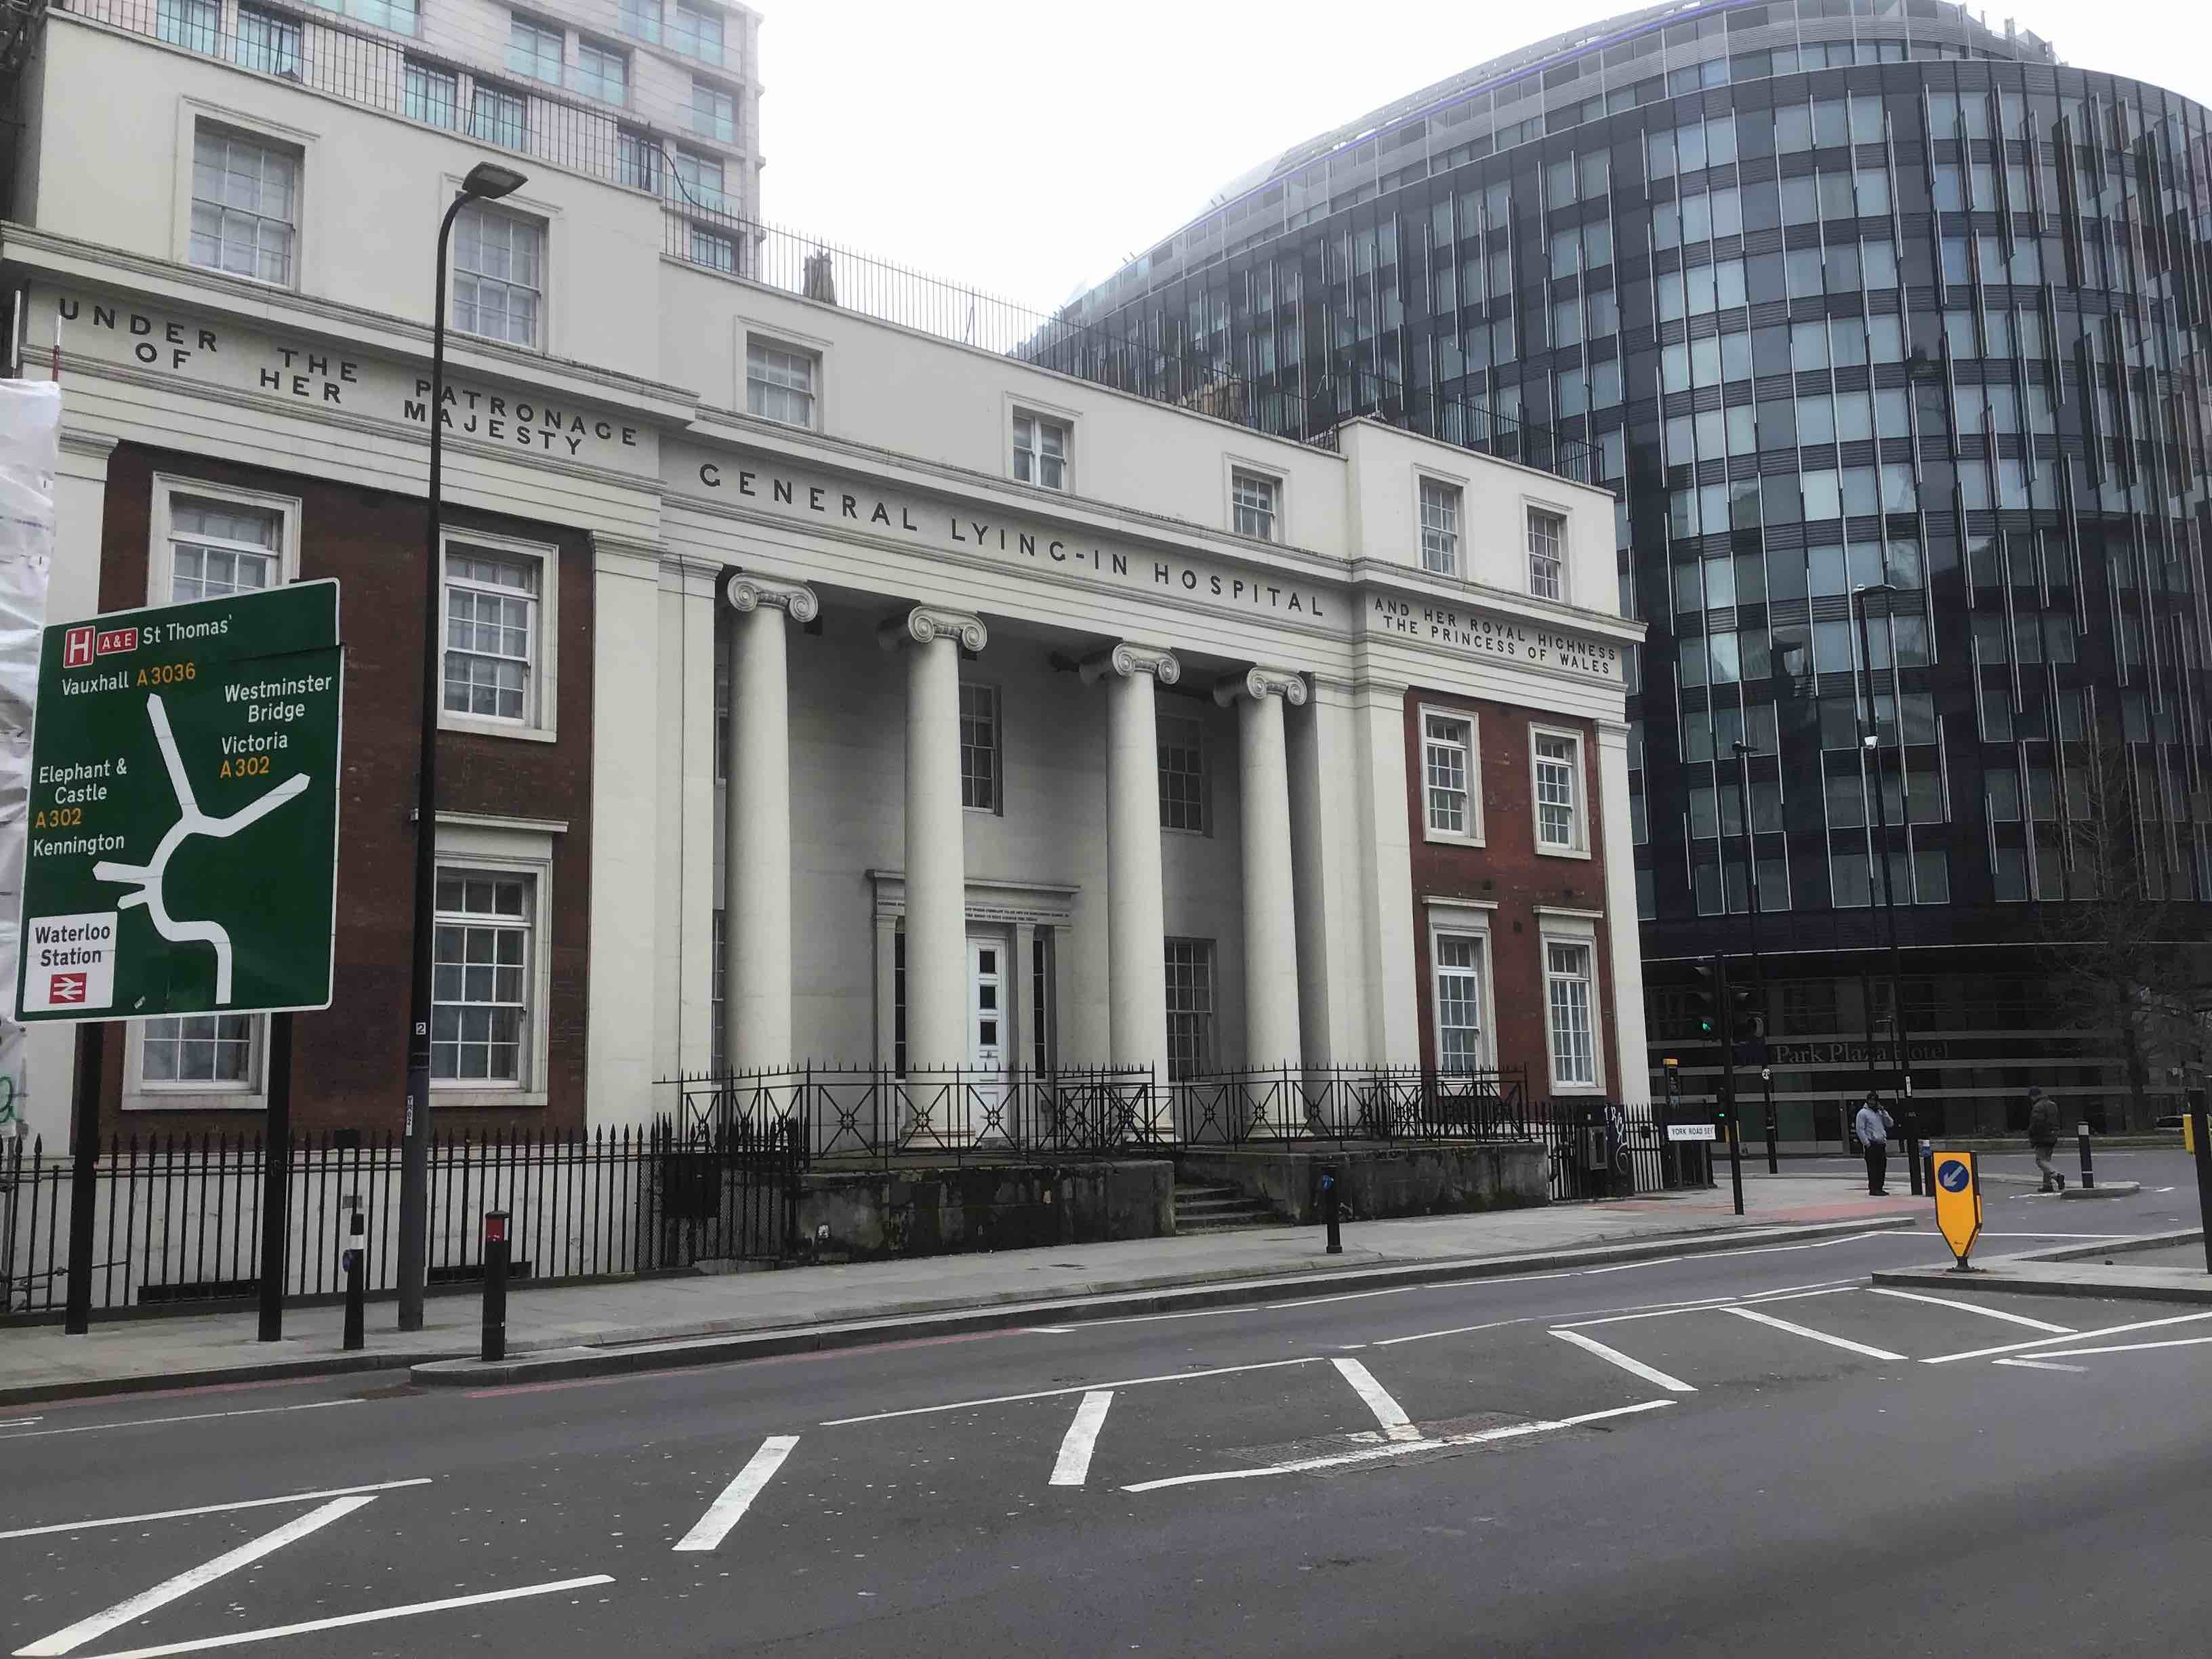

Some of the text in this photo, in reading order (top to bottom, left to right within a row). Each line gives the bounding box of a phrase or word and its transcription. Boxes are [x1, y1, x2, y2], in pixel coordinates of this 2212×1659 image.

[59, 298, 636, 447] UNDER THE PATRONAGE
[135, 342, 581, 455] OF HER MAJESTY
[699, 464, 1324, 617] GENERAL LYING-IN HOSPITAL
[143, 626, 161, 644] St
[167, 614, 232, 642] Thomas'
[1374, 597, 1616, 661] AND HER ROYAL HIGHNESS
[1383, 615, 1610, 674] THE PRINCESS OF WALES
[62, 671, 129, 695] Vauxhall
[224, 674, 332, 703] Westminster
[248, 701, 305, 722] Bridge
[222, 731, 288, 755] Victoria
[39, 758, 127, 785] Elephant &
[55, 783, 107, 804] Castle
[33, 834, 125, 857] Kennington
[35, 923, 110, 944] Waterloo
[41, 947, 102, 966] Station
[417, 1023, 425, 1034] 2
[1776, 1044, 1824, 1063] Park
[1671, 1128, 1687, 1136] YORK
[1689, 1127, 1703, 1135] ROAD
